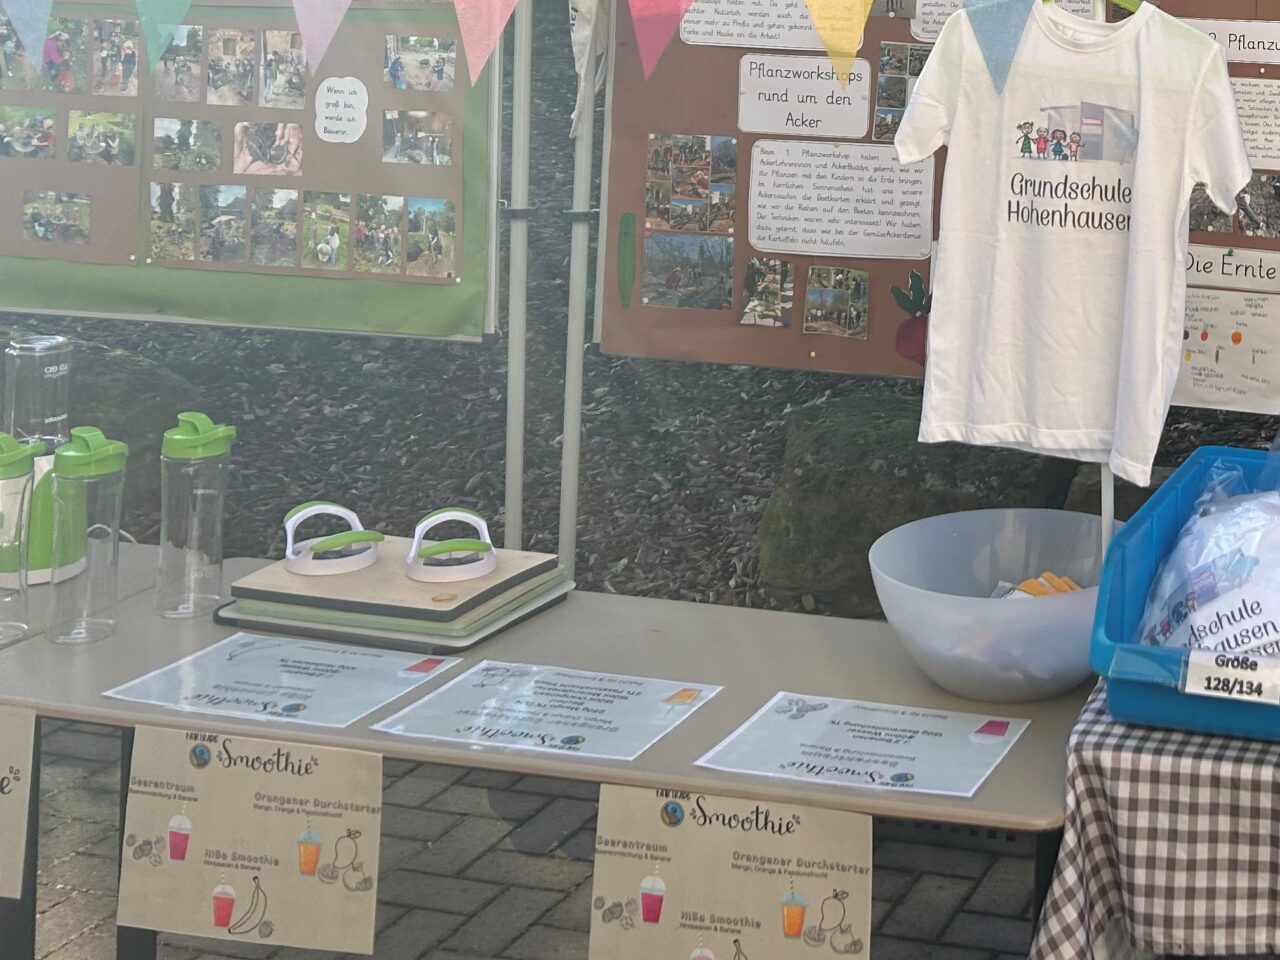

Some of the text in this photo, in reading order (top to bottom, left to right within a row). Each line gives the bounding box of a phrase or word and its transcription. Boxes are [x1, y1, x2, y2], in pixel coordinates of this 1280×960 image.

[749, 61, 862, 85] Pflanzworkshops
[758, 88, 852, 105] rund um den
[785, 112, 822, 128] Acker
[1011, 172, 1132, 204] Grundschule
[1221, 253, 1277, 281] Ernte
[1215, 654, 1258, 671] Größe
[1204, 676, 1263, 697] 128/134
[221, 738, 313, 776] Smoothie
[695, 795, 795, 836] Smoothie
